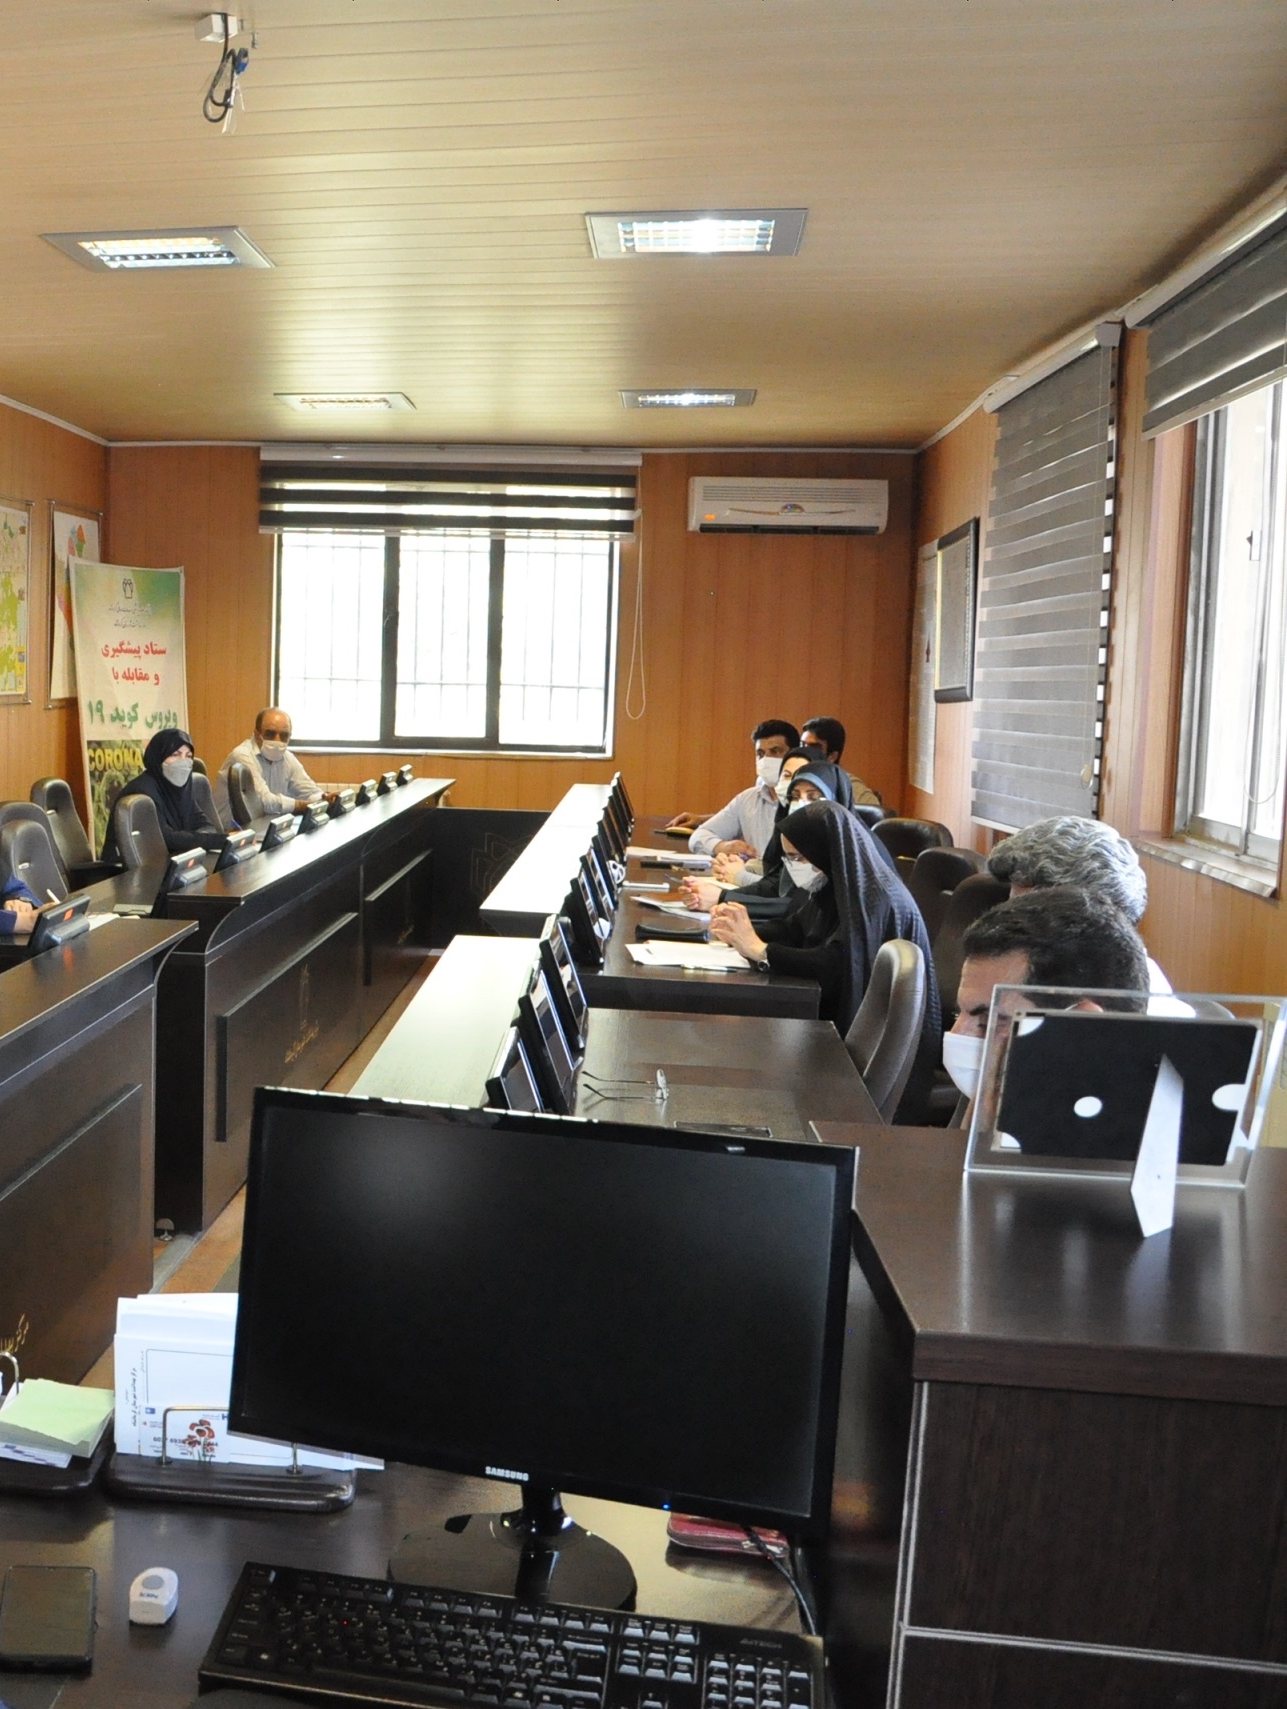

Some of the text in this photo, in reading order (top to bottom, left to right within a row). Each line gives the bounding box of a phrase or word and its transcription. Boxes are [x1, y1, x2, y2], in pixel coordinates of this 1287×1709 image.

[101, 640, 167, 660] ستاد پیشگیری
[111, 666, 160, 686] و مقابله با
[110, 702, 139, 729] کوید
[145, 709, 178, 730] ویروس
[88, 748, 142, 772] CORONA
[485, 1466, 529, 1481] SAMSUNG
